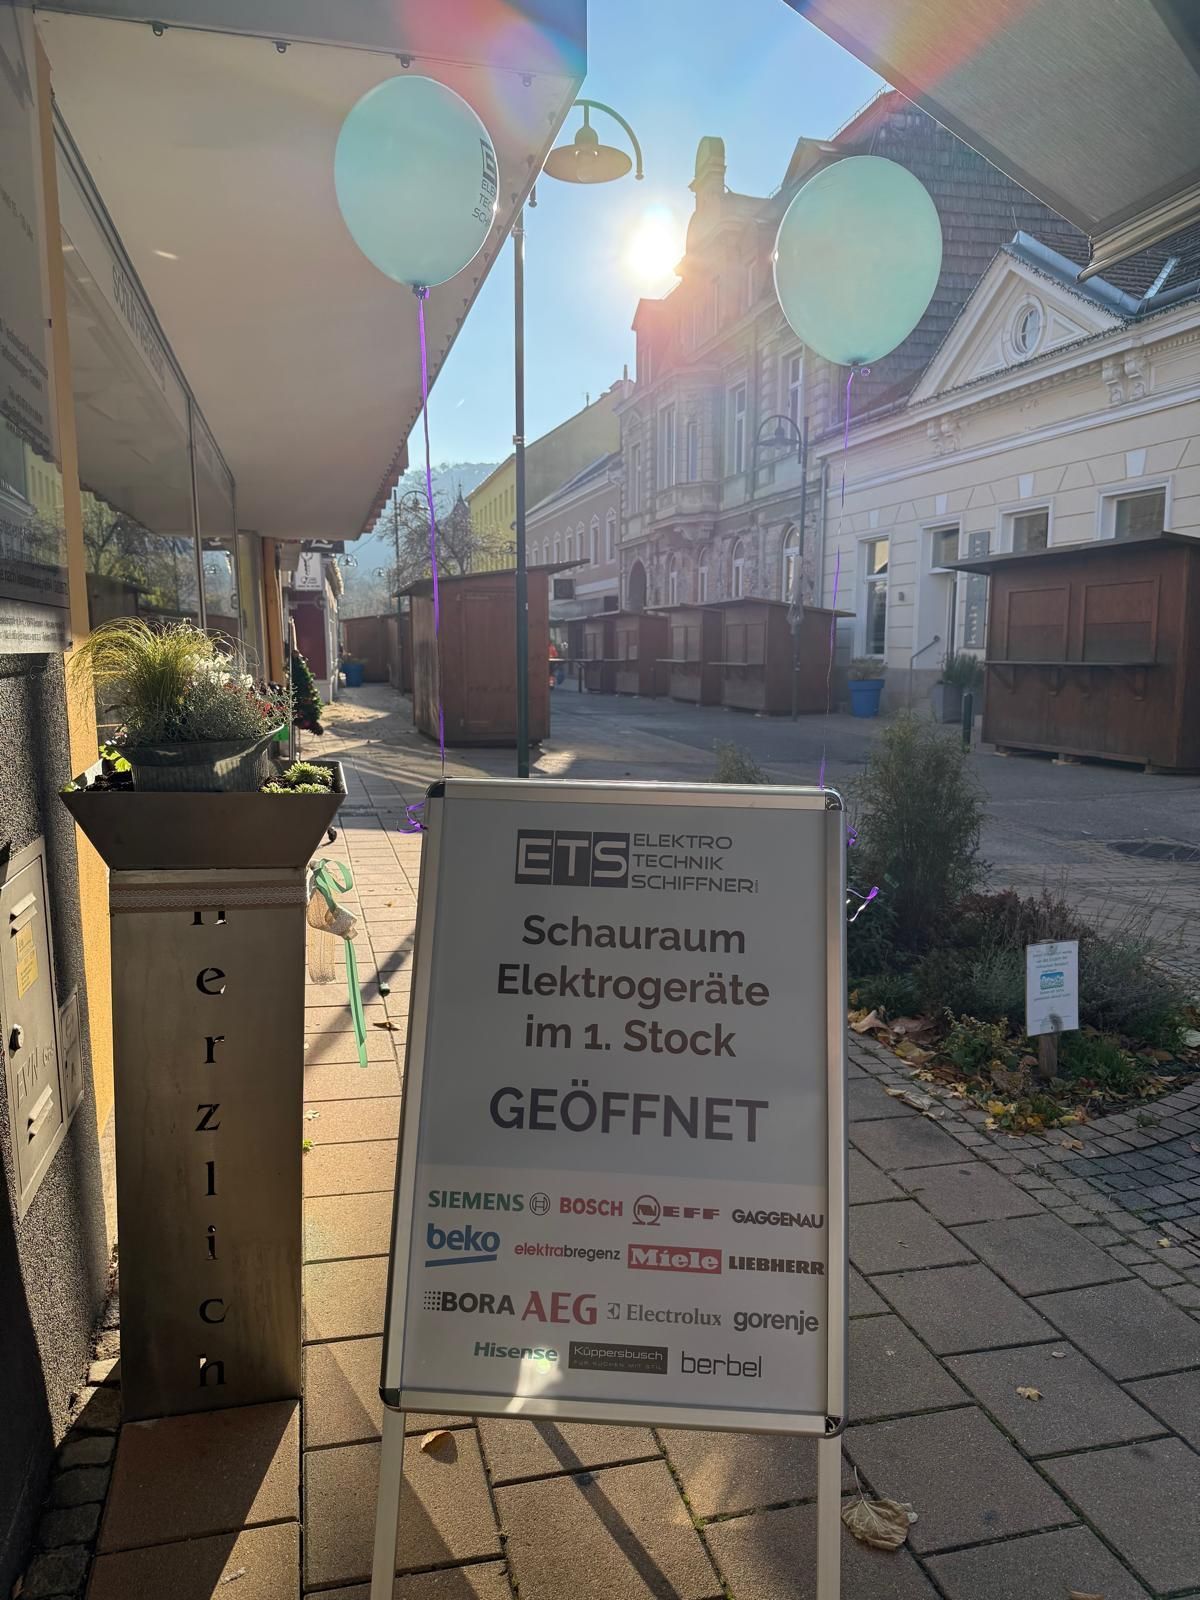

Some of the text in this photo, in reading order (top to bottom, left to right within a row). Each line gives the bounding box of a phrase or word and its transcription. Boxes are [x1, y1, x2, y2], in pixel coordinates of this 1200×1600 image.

[517, 838, 627, 878] ETS
[633, 833, 733, 849] ELEKTRO
[632, 854, 724, 870] TECHNIK
[631, 874, 754, 893] SCHIFFNER
[522, 915, 745, 954] Schauraum
[497, 963, 770, 1010] Elektrogeräte
[525, 1014, 737, 1058] im 1. Stock
[489, 1079, 769, 1143] GEÖFFNET
[428, 1190, 824, 1229] SIEMENS BOSCH NEFF GAGGENAU
[426, 1223, 825, 1275] beko elektrabregenz Miele LIEBHERR
[442, 1290, 819, 1335] BORA AEG Electrolux gorenje
[474, 1341, 762, 1378] Hisense Küppersbusch berbel
